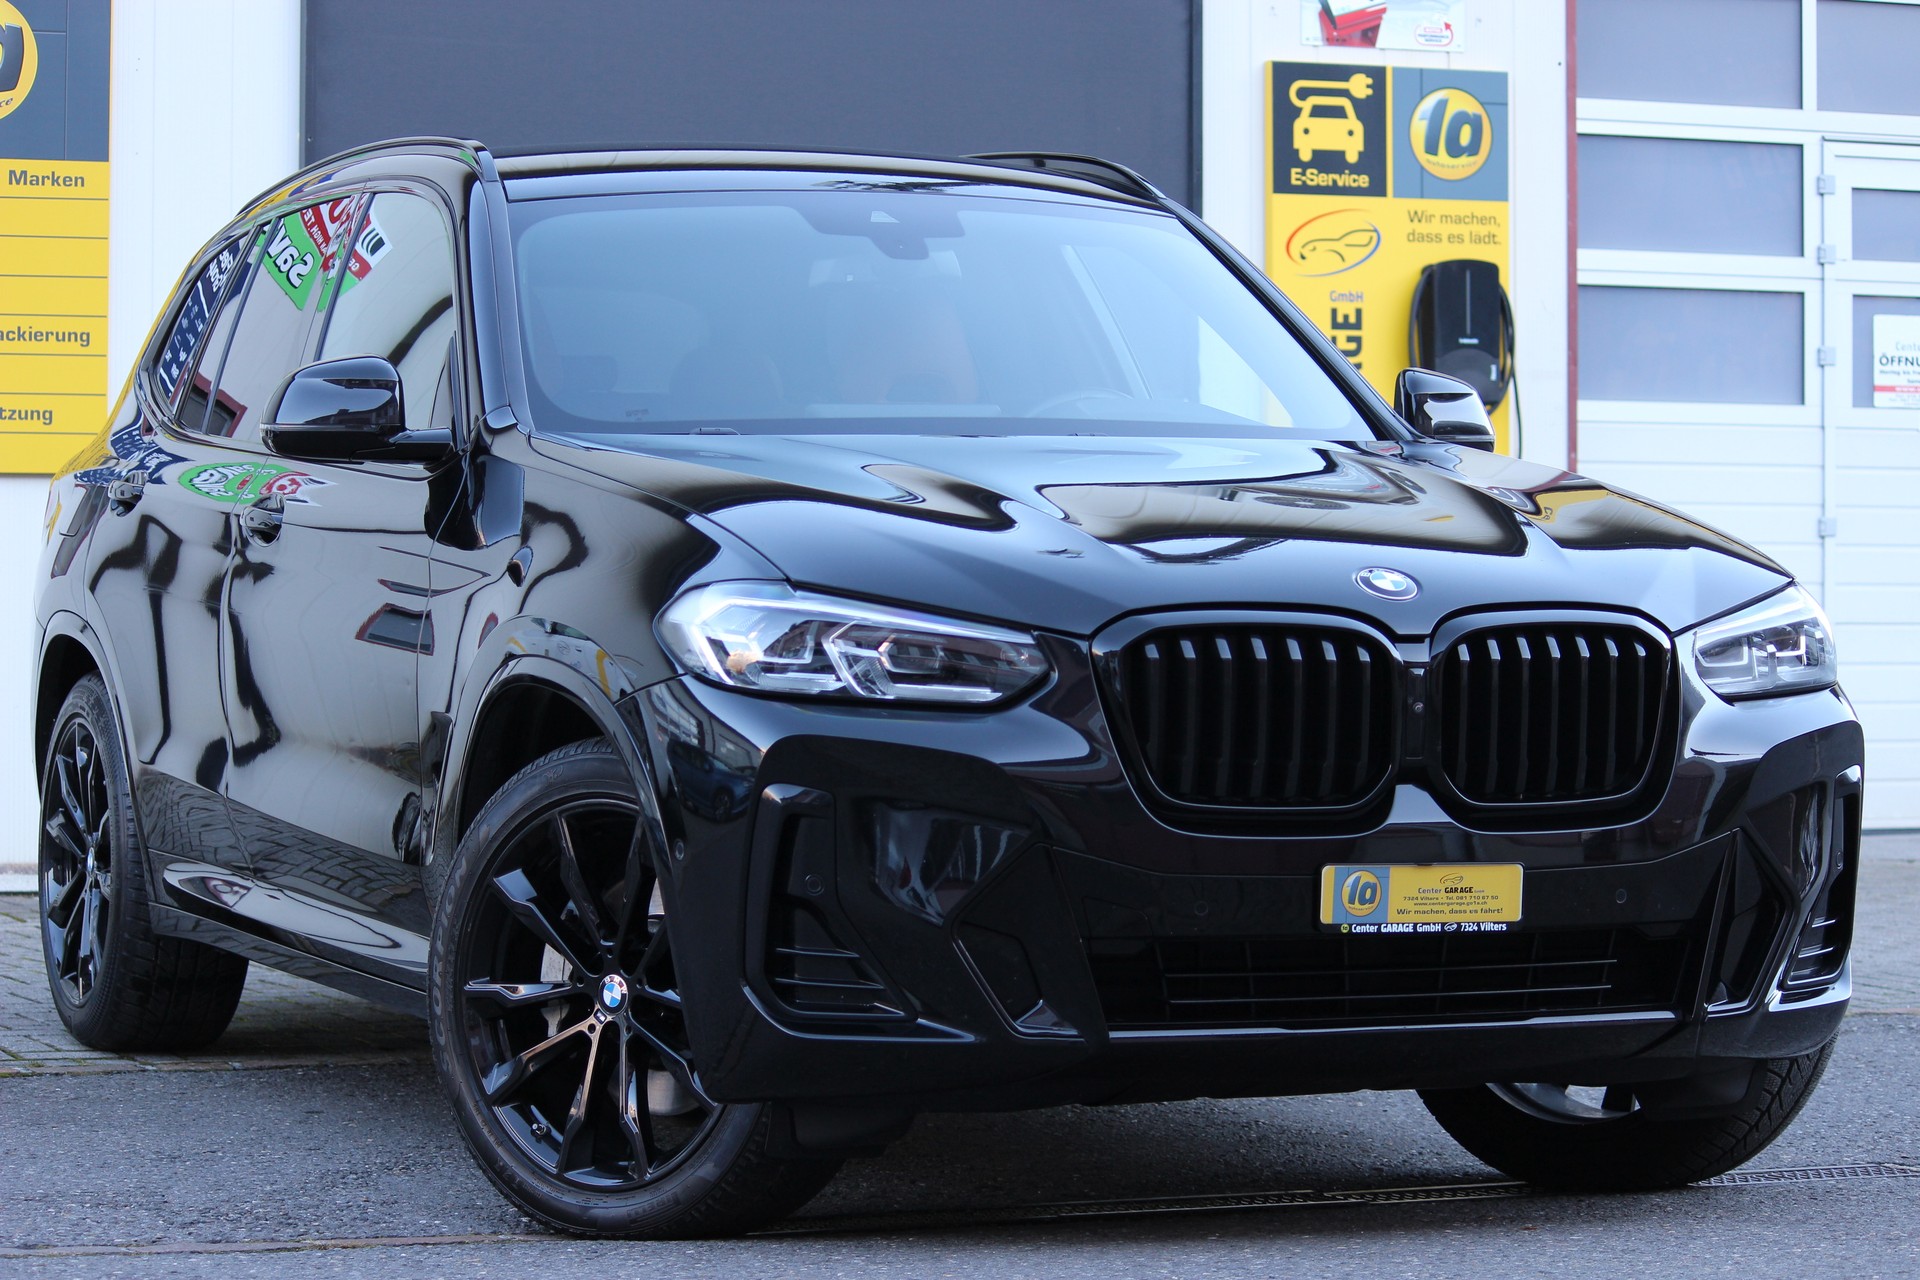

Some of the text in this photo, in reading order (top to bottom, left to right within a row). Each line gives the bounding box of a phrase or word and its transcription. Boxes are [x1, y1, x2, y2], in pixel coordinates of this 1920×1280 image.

[1418, 97, 1483, 158] 1a
[8, 169, 85, 187] Marken
[1290, 168, 1370, 188] E-Service
[1408, 210, 1501, 227] Wir machen,
[1407, 229, 1502, 245] dass es lädt.
[1329, 290, 1364, 303] GmbH
[1331, 308, 1363, 371] GE
[1346, 875, 1378, 906] 1a
[1418, 887, 1442, 895] Center
[1444, 886, 1474, 894] GARAGE
[1414, 908, 1447, 916] machen,
[1351, 924, 1378, 933] Center
[1381, 923, 1414, 933] GARAGE
[1416, 922, 1442, 932] GmbH
[1460, 922, 1479, 932] 7324
[1480, 922, 1507, 931] Vilters
